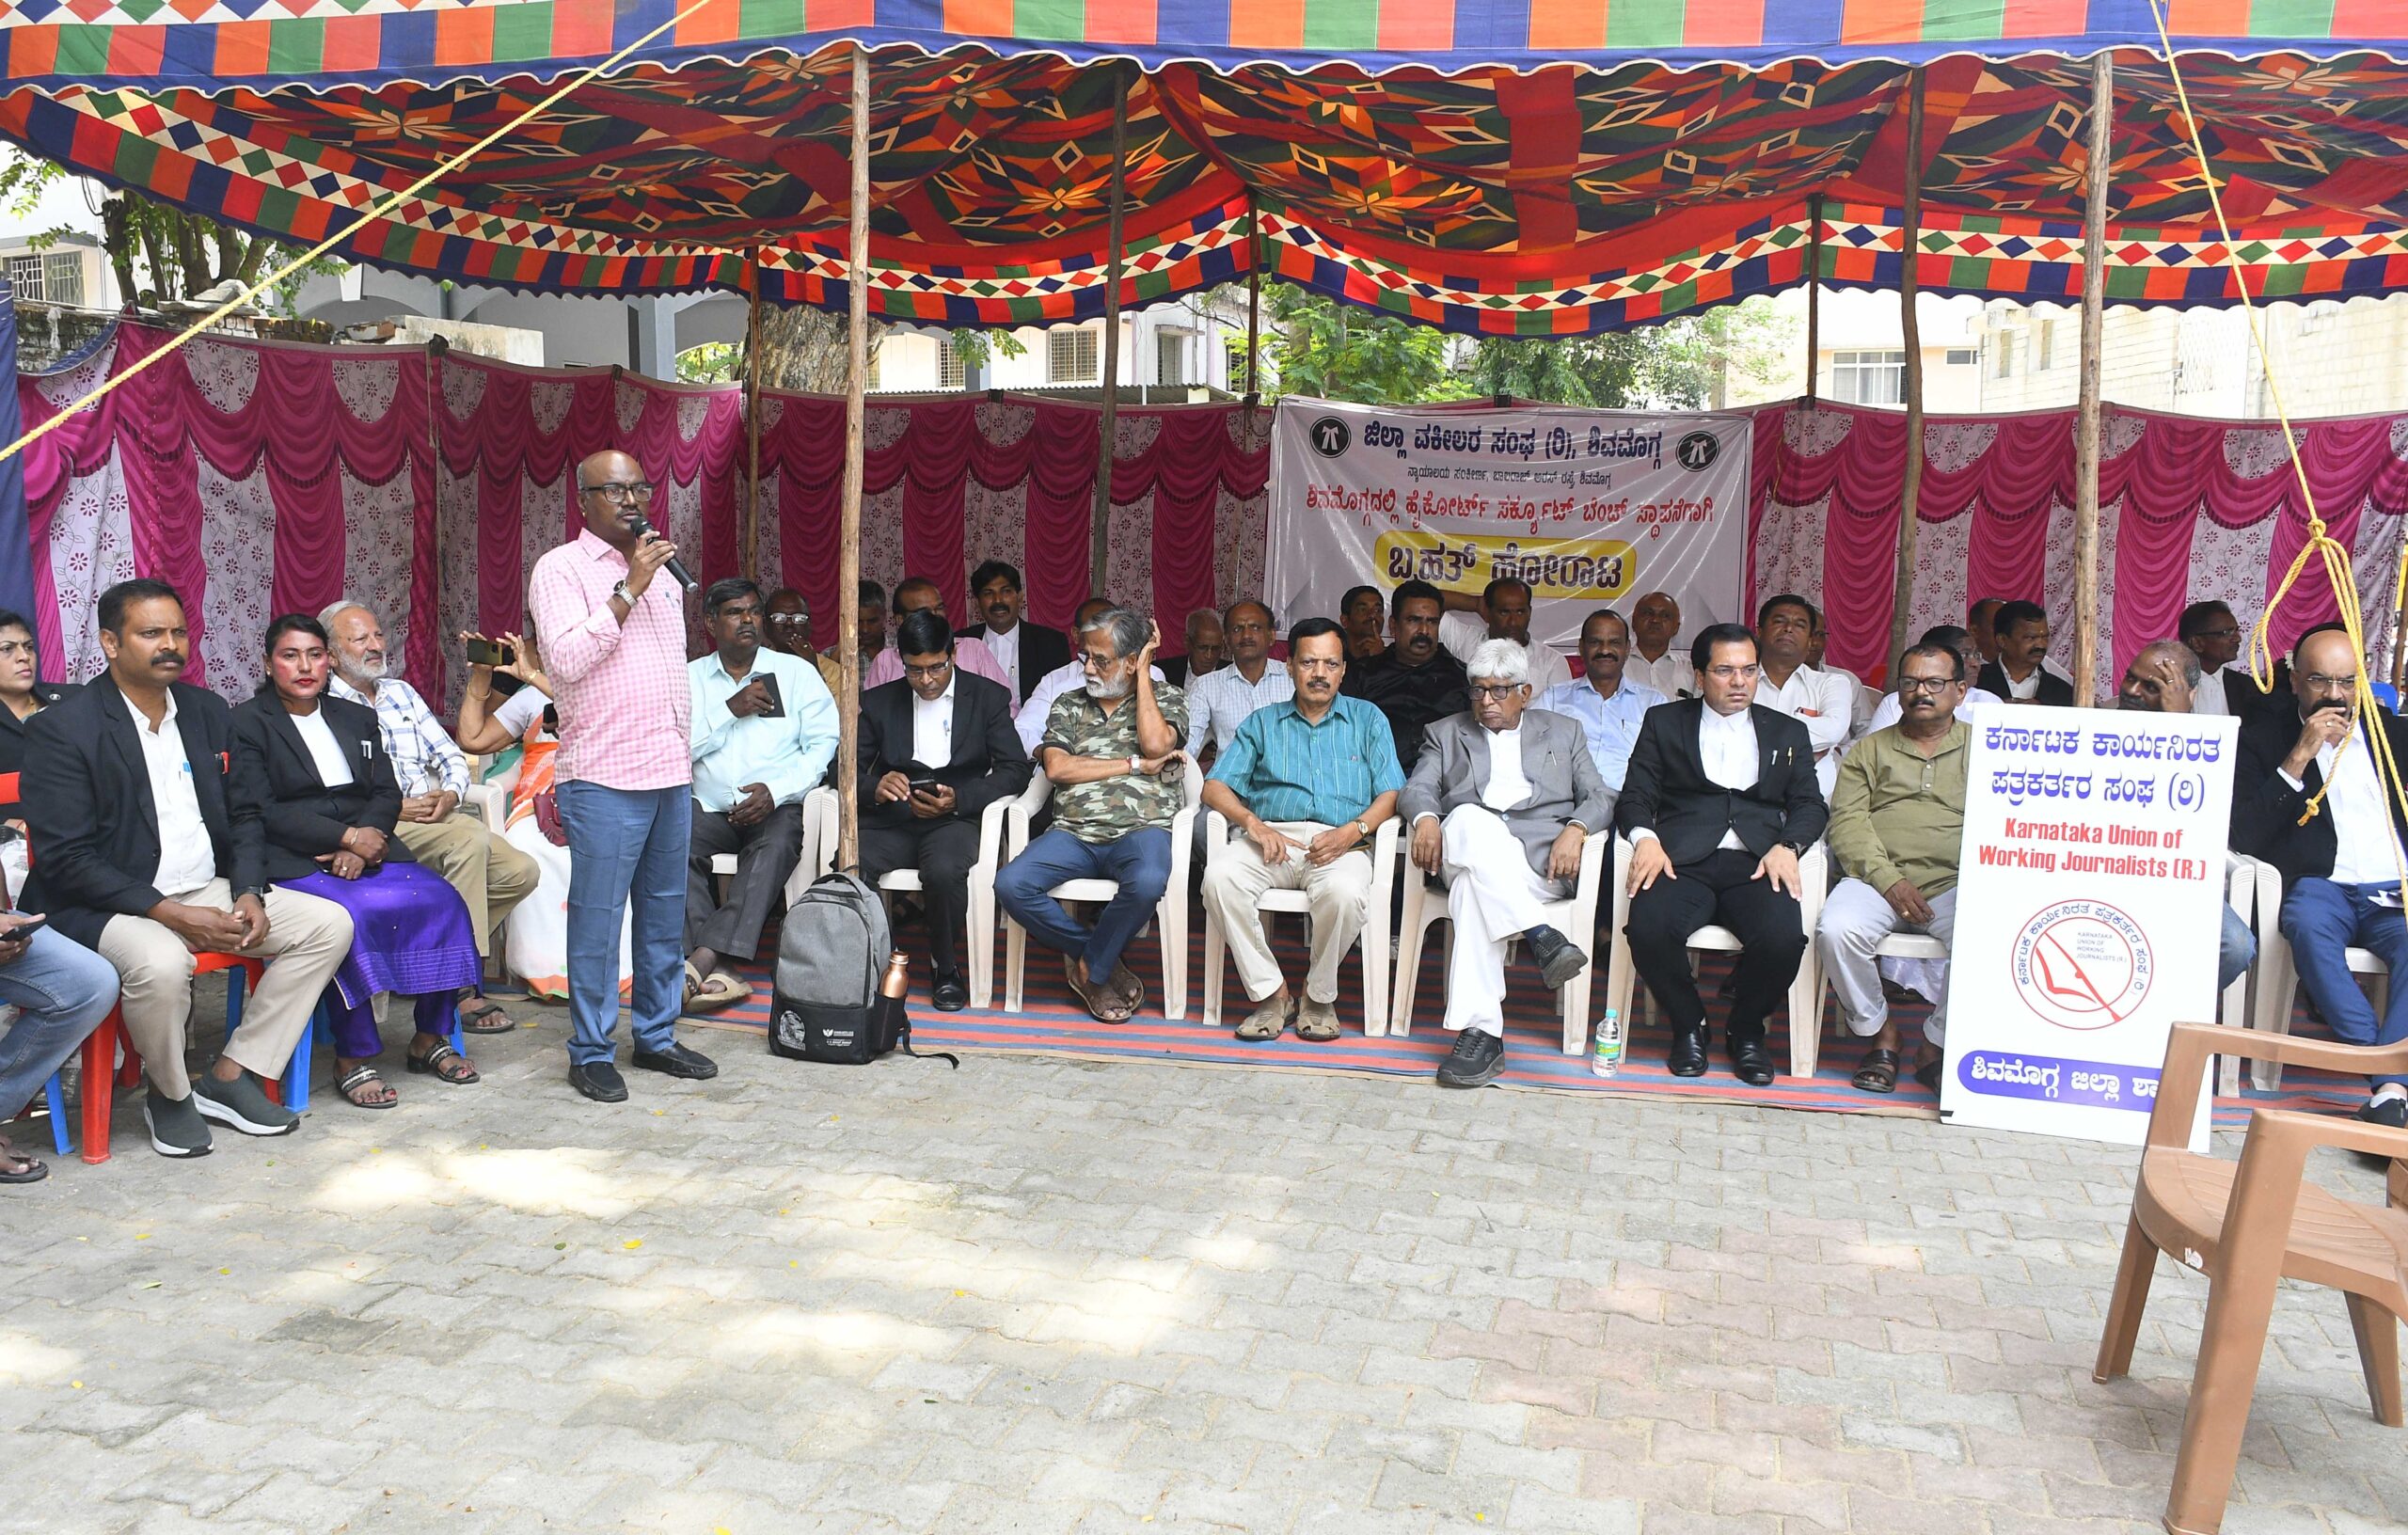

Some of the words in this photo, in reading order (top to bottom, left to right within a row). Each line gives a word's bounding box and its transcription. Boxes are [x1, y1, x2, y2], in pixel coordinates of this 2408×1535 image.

[1364, 420, 1407, 459] ಜಿಲ್ಲಾ
[1415, 423, 1482, 452] ವಕೀಲರ
[1491, 426, 1536, 461] ಸಂಘ
[1587, 425, 1662, 469] ಶಿವಮೊಗ್ಗ
[1307, 483, 1400, 527] ಶಿವಮೊಗ್ಗದಲ್ಲಿ
[1405, 489, 1490, 529] ಹೈಕೋರ್ಟ್
[1497, 495, 1575, 535] ಸರ್ಕ್ಯೂಟ್
[1582, 497, 1628, 522] ಬೆಂಚ್
[1636, 496, 1715, 541] ಸ್ಥಾಪನೆಗಾಗಿ
[1491, 542, 1624, 589] ಹೋರಾಟ
[1986, 720, 2081, 754] ಕರ್ನಾಟಕ
[2092, 728, 2222, 763] ಕಾರ್ಯನಿರತ
[1991, 765, 2093, 806] ಪತ್ರಕರ್ತರ
[2103, 770, 2156, 808] ಸಂಘ
[2168, 771, 2205, 813] (ರಿ)
[2004, 817, 2103, 844] Karnataka
[2108, 824, 2159, 847] Union
[2163, 829, 2184, 849] of
[1979, 845, 2056, 873] Working
[2061, 850, 2168, 878] Journalists
[2173, 858, 2207, 881] (R.)
[2077, 953, 2115, 961] JOURNALISTS
[1971, 1055, 2061, 1100] ಶಿವಮೊಗ್ಗ
[2070, 1070, 2121, 1102] ಜಿಲ್ಲಾ
[2131, 1077, 2160, 1099] ಶಾ
